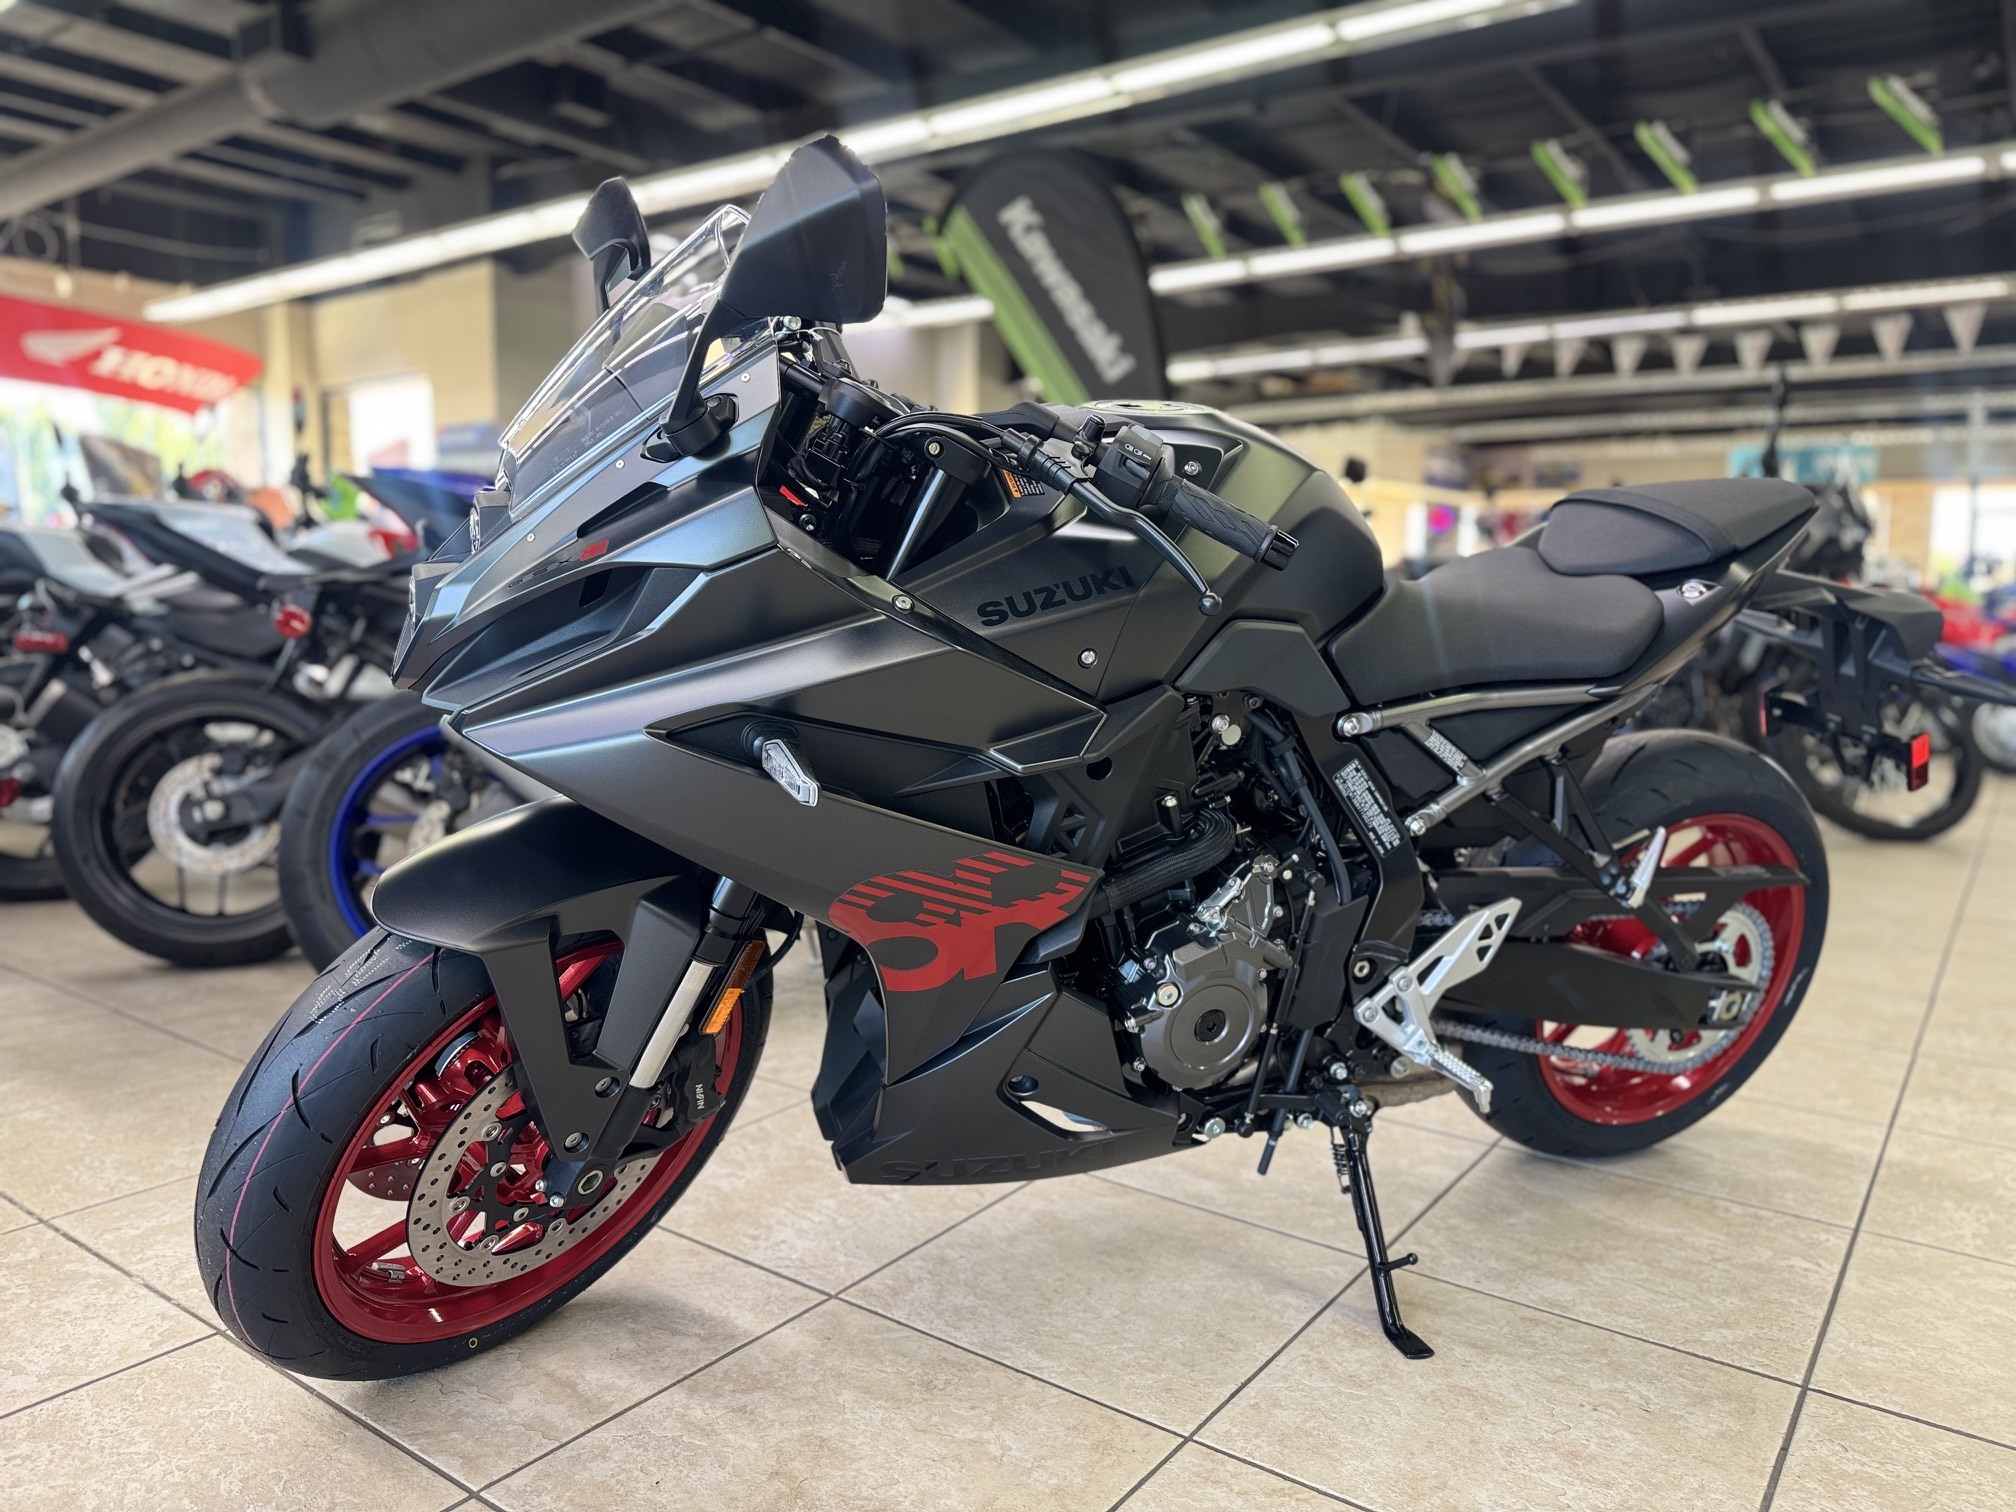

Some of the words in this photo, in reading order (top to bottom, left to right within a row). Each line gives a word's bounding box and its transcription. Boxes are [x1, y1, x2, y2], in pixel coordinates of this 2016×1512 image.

[996, 195, 1137, 385] Kawasaki
[976, 565, 1135, 627] SUZUKI
[880, 1139, 1116, 1183] SUZUKI
